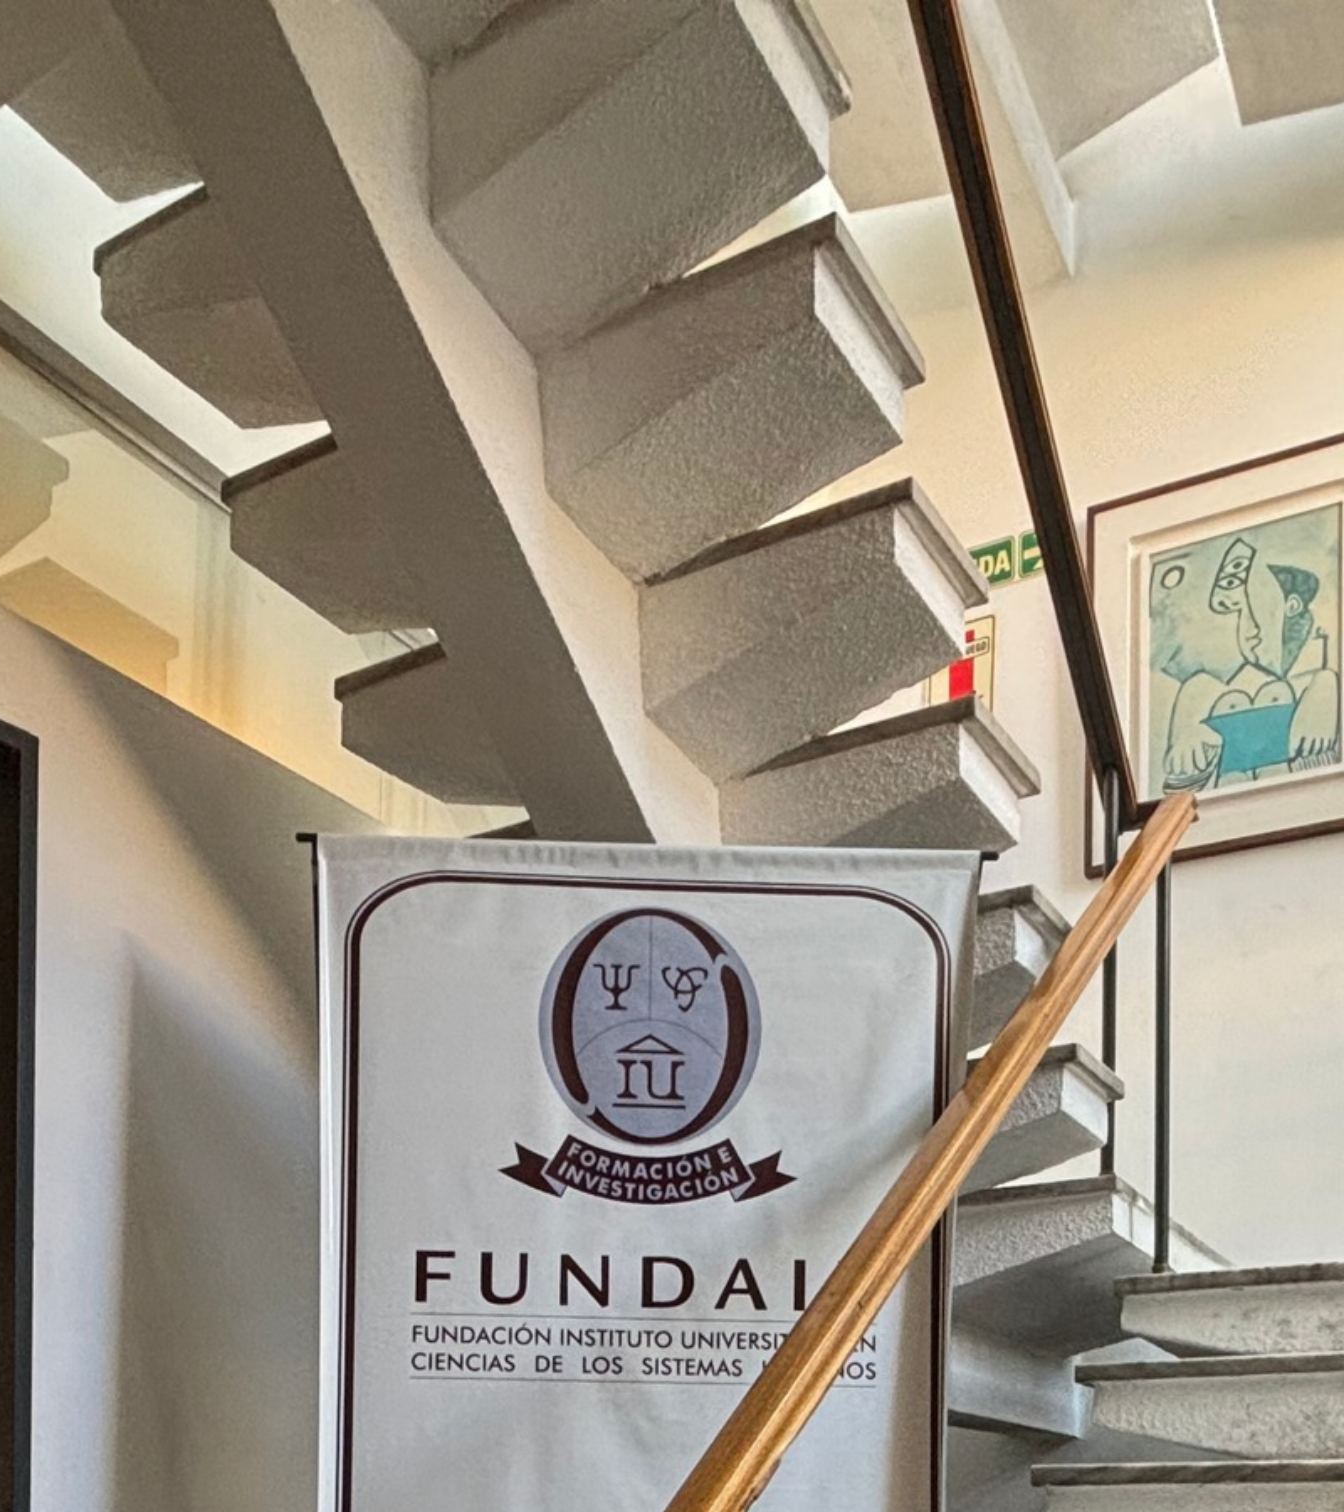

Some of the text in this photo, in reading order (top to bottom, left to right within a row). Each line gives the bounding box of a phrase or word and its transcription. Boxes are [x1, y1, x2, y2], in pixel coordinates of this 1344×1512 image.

[567, 1142, 732, 1180] FORMACIÓN E
[557, 1161, 739, 1200] INVESTIGACIÓN
[414, 1249, 807, 1311] FUNDAI
[411, 1323, 552, 1345] FUNDACIÓN
[559, 1328, 673, 1349] INSTITUTO
[411, 1352, 515, 1372] CIENCIAS
[534, 1355, 563, 1373] DE
[582, 1356, 623, 1375] LOS
[641, 1358, 743, 1377] SISTEMAS
